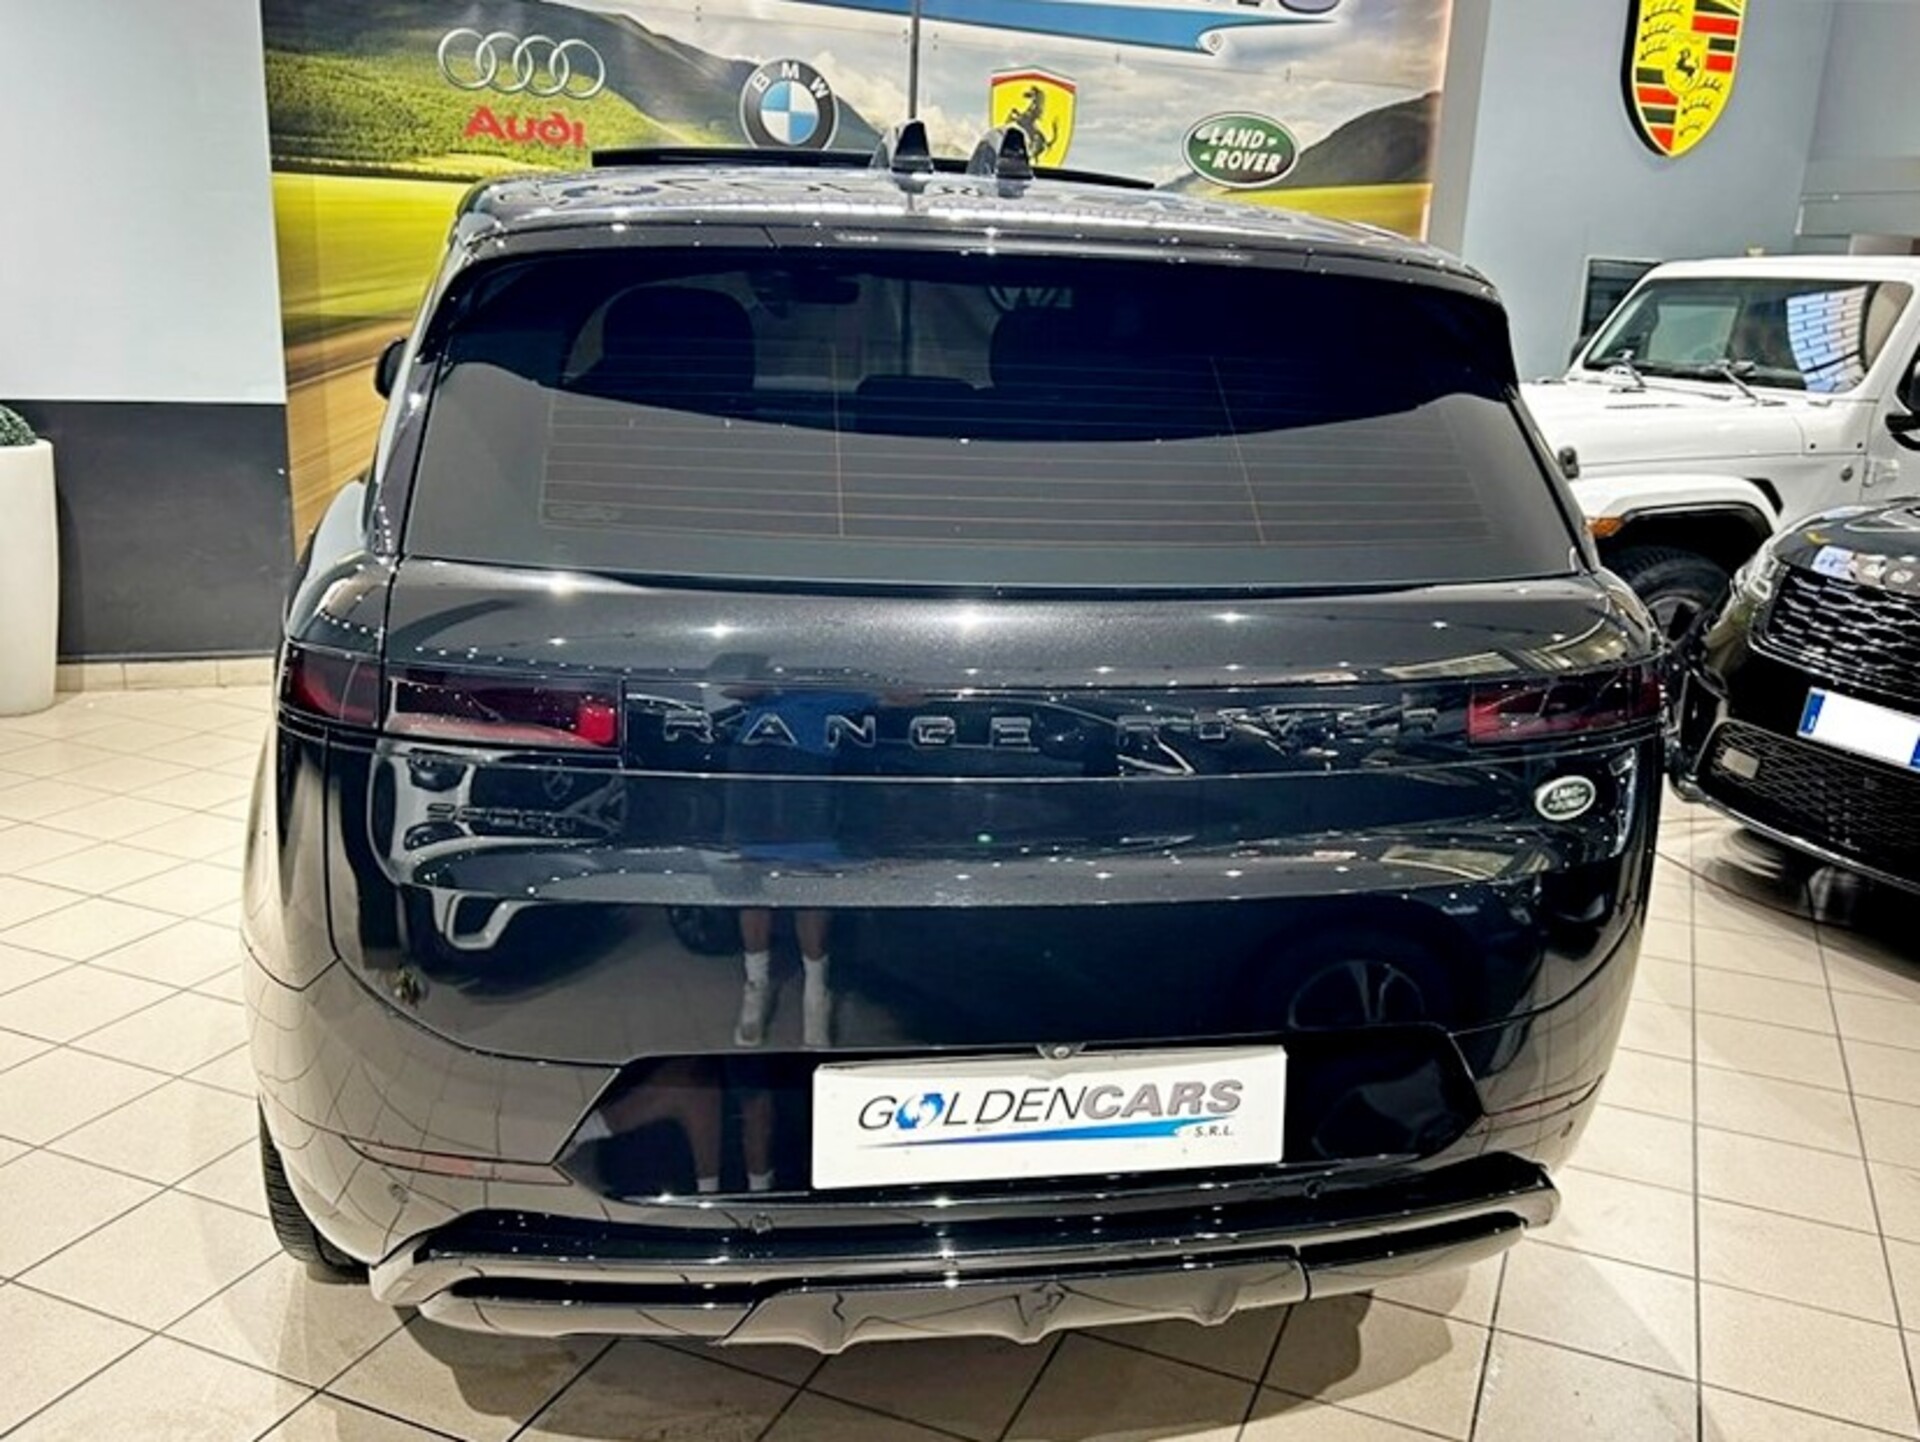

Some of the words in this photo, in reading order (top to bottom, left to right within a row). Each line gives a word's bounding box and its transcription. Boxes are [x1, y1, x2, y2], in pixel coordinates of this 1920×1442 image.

[752, 61, 830, 99] BMW
[463, 105, 584, 148] Audi
[1208, 126, 1266, 149] LAND
[1211, 149, 1283, 174] ROVER
[664, 710, 1032, 749] RANGE
